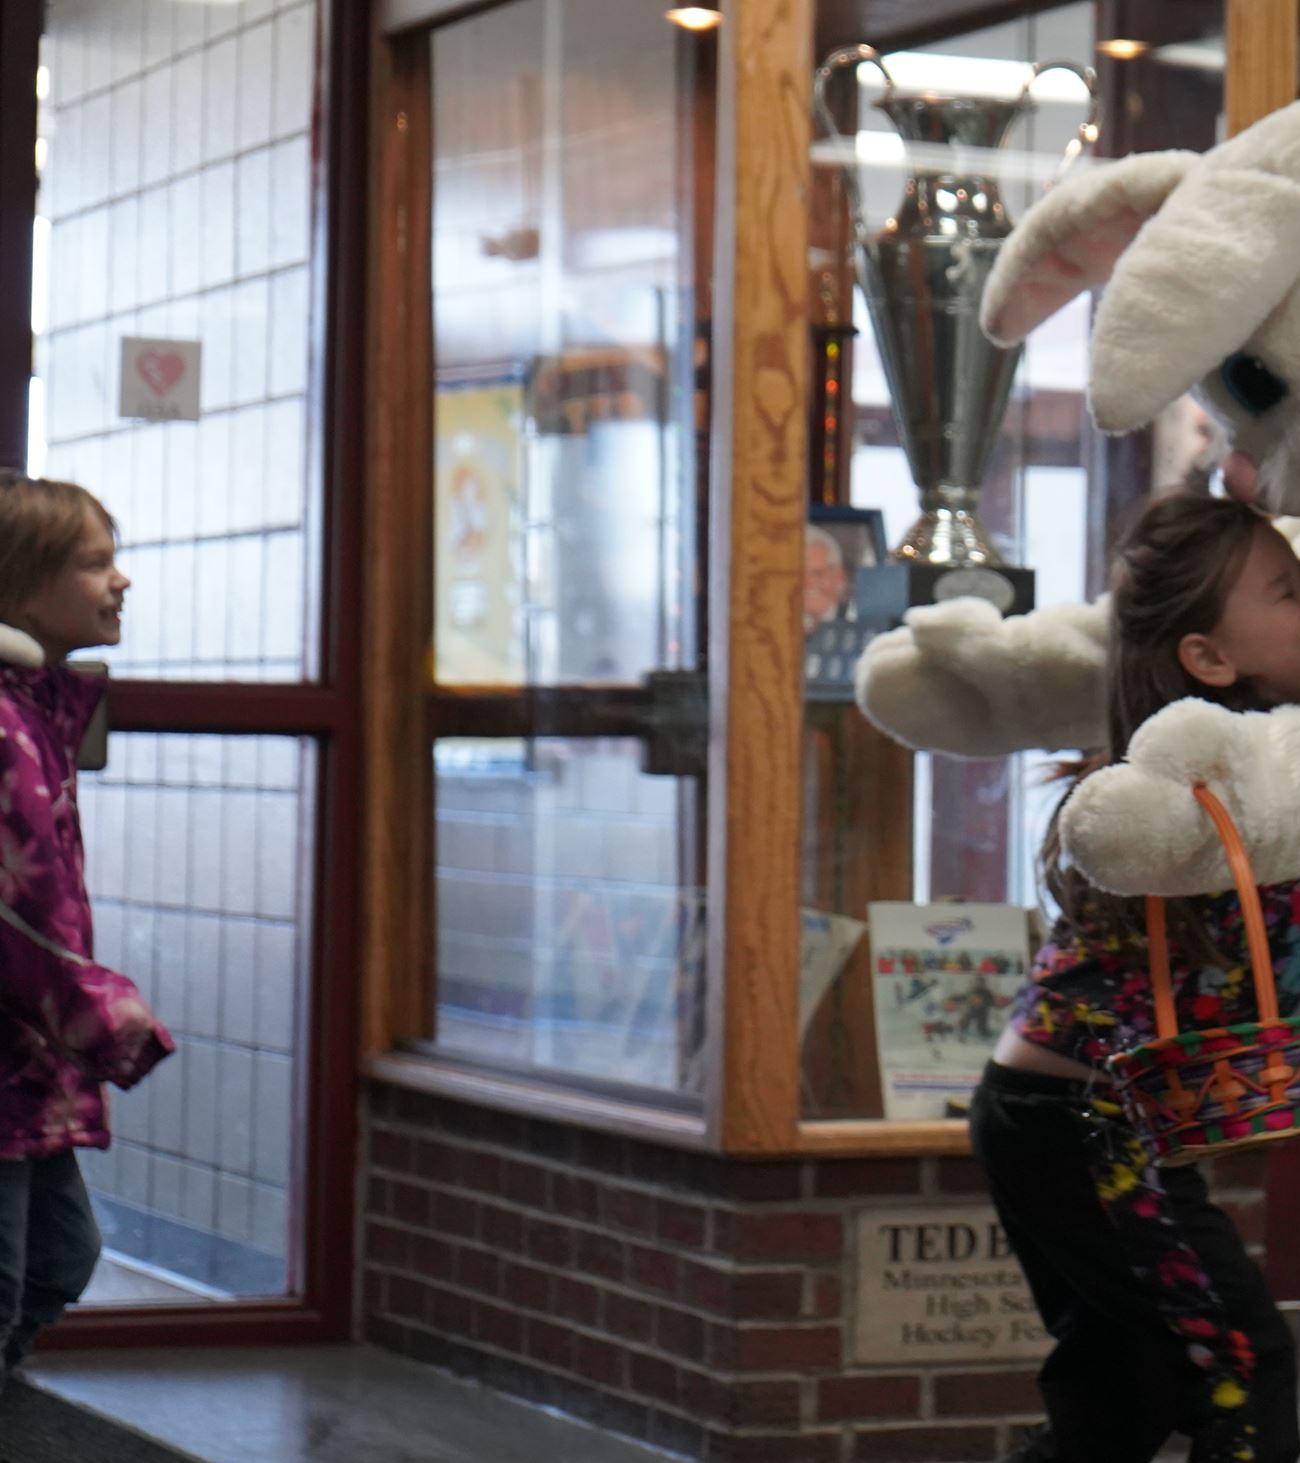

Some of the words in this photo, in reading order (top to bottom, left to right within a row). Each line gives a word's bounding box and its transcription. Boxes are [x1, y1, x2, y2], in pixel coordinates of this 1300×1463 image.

[879, 1222, 978, 1263] TED
[925, 1292, 992, 1319] High
[901, 1321, 997, 1348] Hockey
